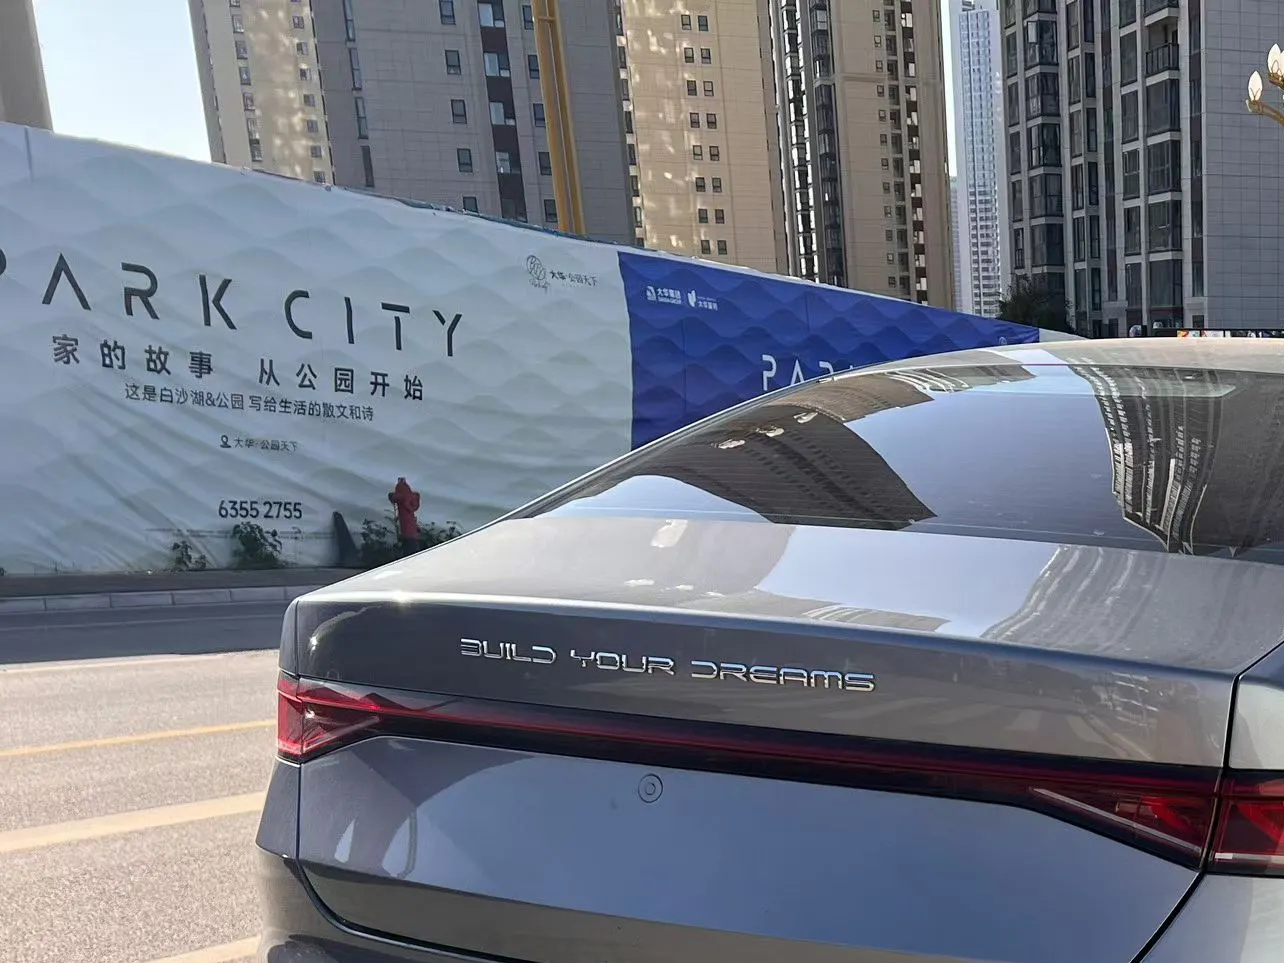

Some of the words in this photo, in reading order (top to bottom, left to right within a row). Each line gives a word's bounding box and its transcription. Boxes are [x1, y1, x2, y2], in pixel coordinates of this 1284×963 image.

[0, 248, 237, 330] ARK
[285, 289, 463, 357] CITY
[52, 334, 214, 378] 家的故事
[258, 358, 423, 401] 从公园开始
[125, 383, 244, 411] 这是白沙湖&公园
[249, 395, 374, 422] 写给生活的散文和诗
[218, 500, 260, 519] 6355
[263, 500, 303, 519] 2755
[460, 638, 557, 665] BUILD
[570, 648, 675, 676] YOUR
[691, 660, 876, 693] DREAMS
